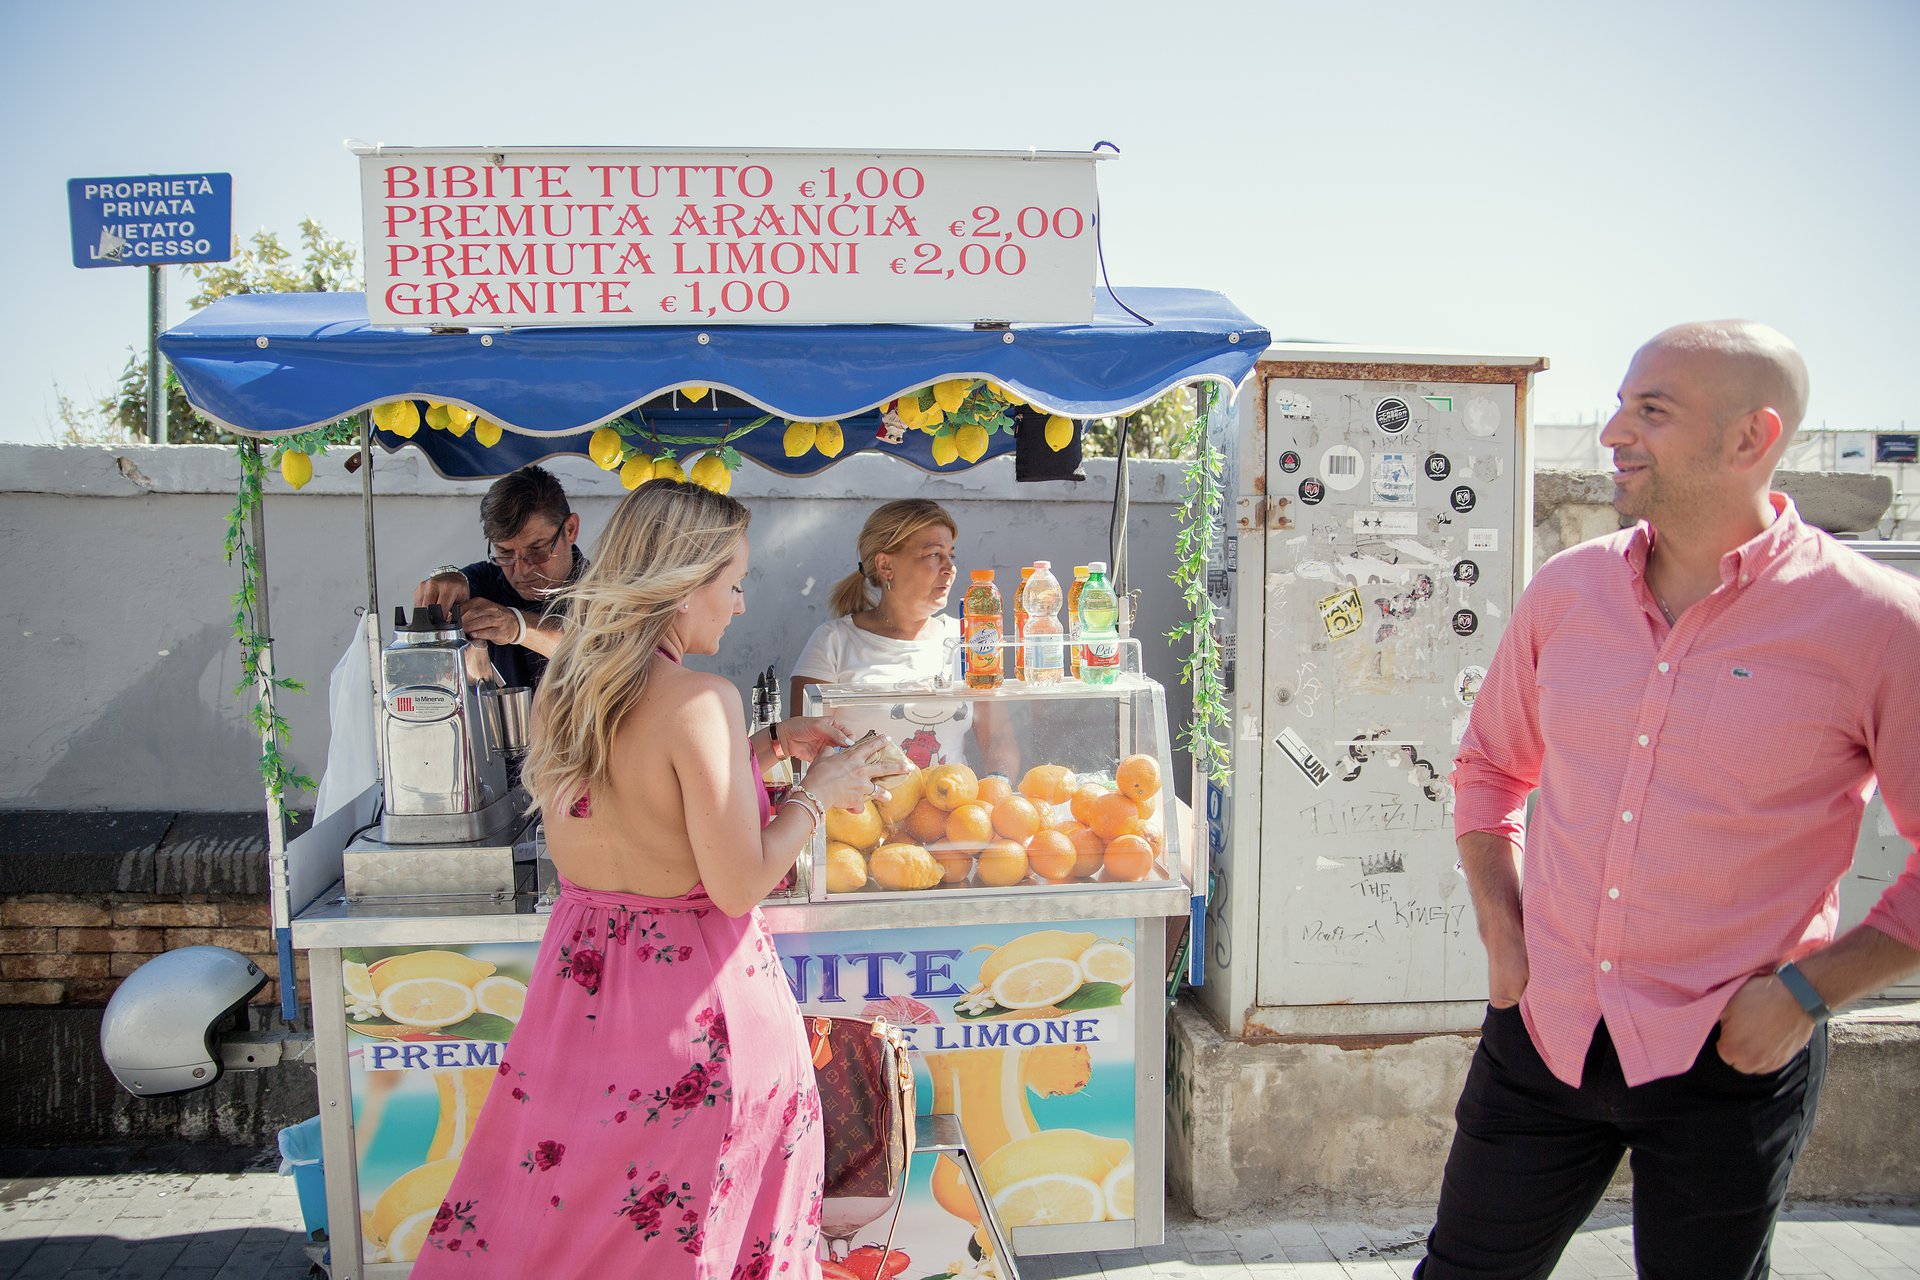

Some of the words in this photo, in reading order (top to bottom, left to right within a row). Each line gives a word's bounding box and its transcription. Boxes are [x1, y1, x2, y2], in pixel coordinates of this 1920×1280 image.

[85, 176, 214, 200] PROPRIETÀ
[383, 165, 573, 199] BIBITE
[588, 165, 774, 199] TUTTO
[798, 166, 925, 203] €1,00
[103, 199, 196, 217] PRIVATA
[383, 204, 654, 241] PREMUTA
[669, 203, 920, 240] ARANCIA
[948, 205, 1085, 243] €2,00
[102, 221, 195, 239] VIETATO
[385, 242, 655, 279] PREMUTA
[673, 241, 859, 276] LIMONI
[889, 243, 1027, 280] €2,00
[385, 281, 633, 318] GRANITE
[659, 280, 791, 318] €1,00
[934, 1018, 1101, 1050] LIMONE
[371, 1041, 508, 1071] PREM
